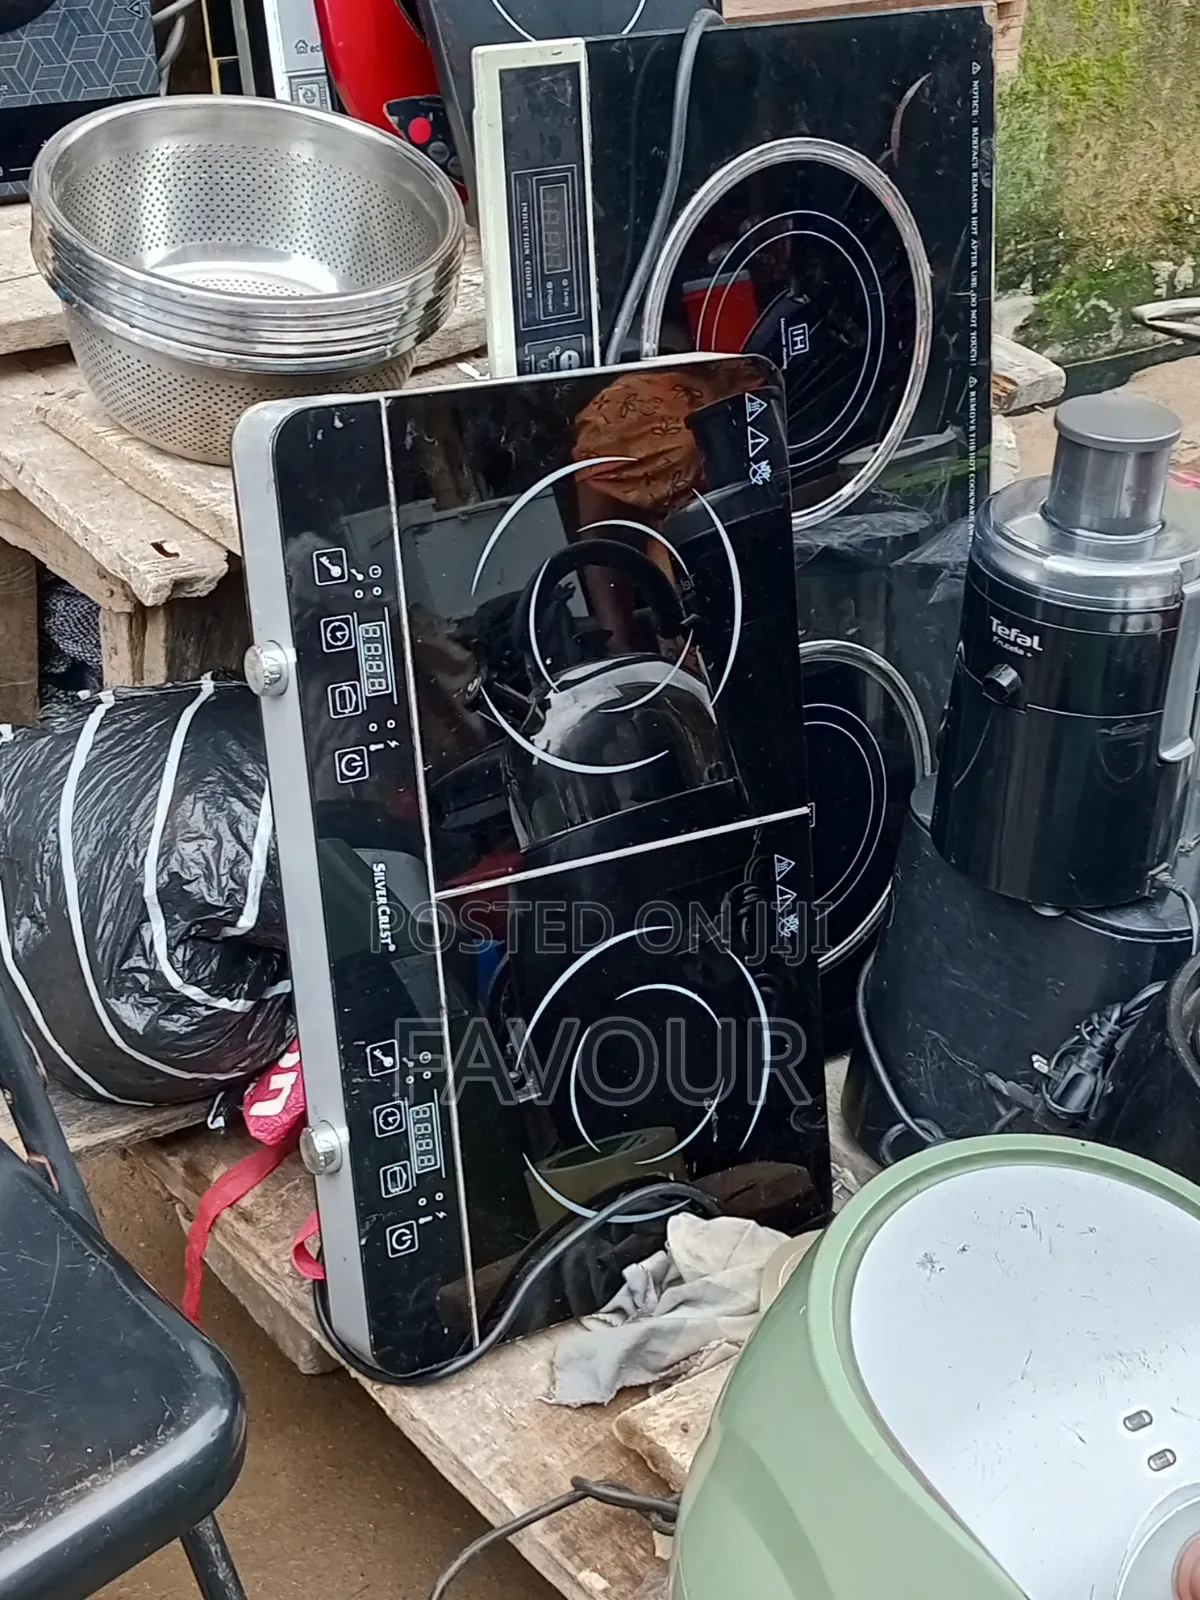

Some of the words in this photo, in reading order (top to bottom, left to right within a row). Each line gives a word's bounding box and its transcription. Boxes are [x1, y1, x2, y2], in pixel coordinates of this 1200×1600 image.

[971, 127, 980, 169] SURFACE
[970, 172, 979, 214] REMAINS
[521, 202, 531, 255] INDUCTION
[970, 216, 979, 235] HOT
[970, 238, 979, 268] AFTER
[524, 260, 533, 299] COOKER
[969, 309, 978, 327] NOT
[792, 329, 805, 351] IH
[968, 390, 977, 432] REMOVE
[968, 433, 977, 452] THE
[968, 452, 977, 472] HOT
[968, 473, 976, 522] COOKWARE
[989, 615, 1043, 651] Tefal
